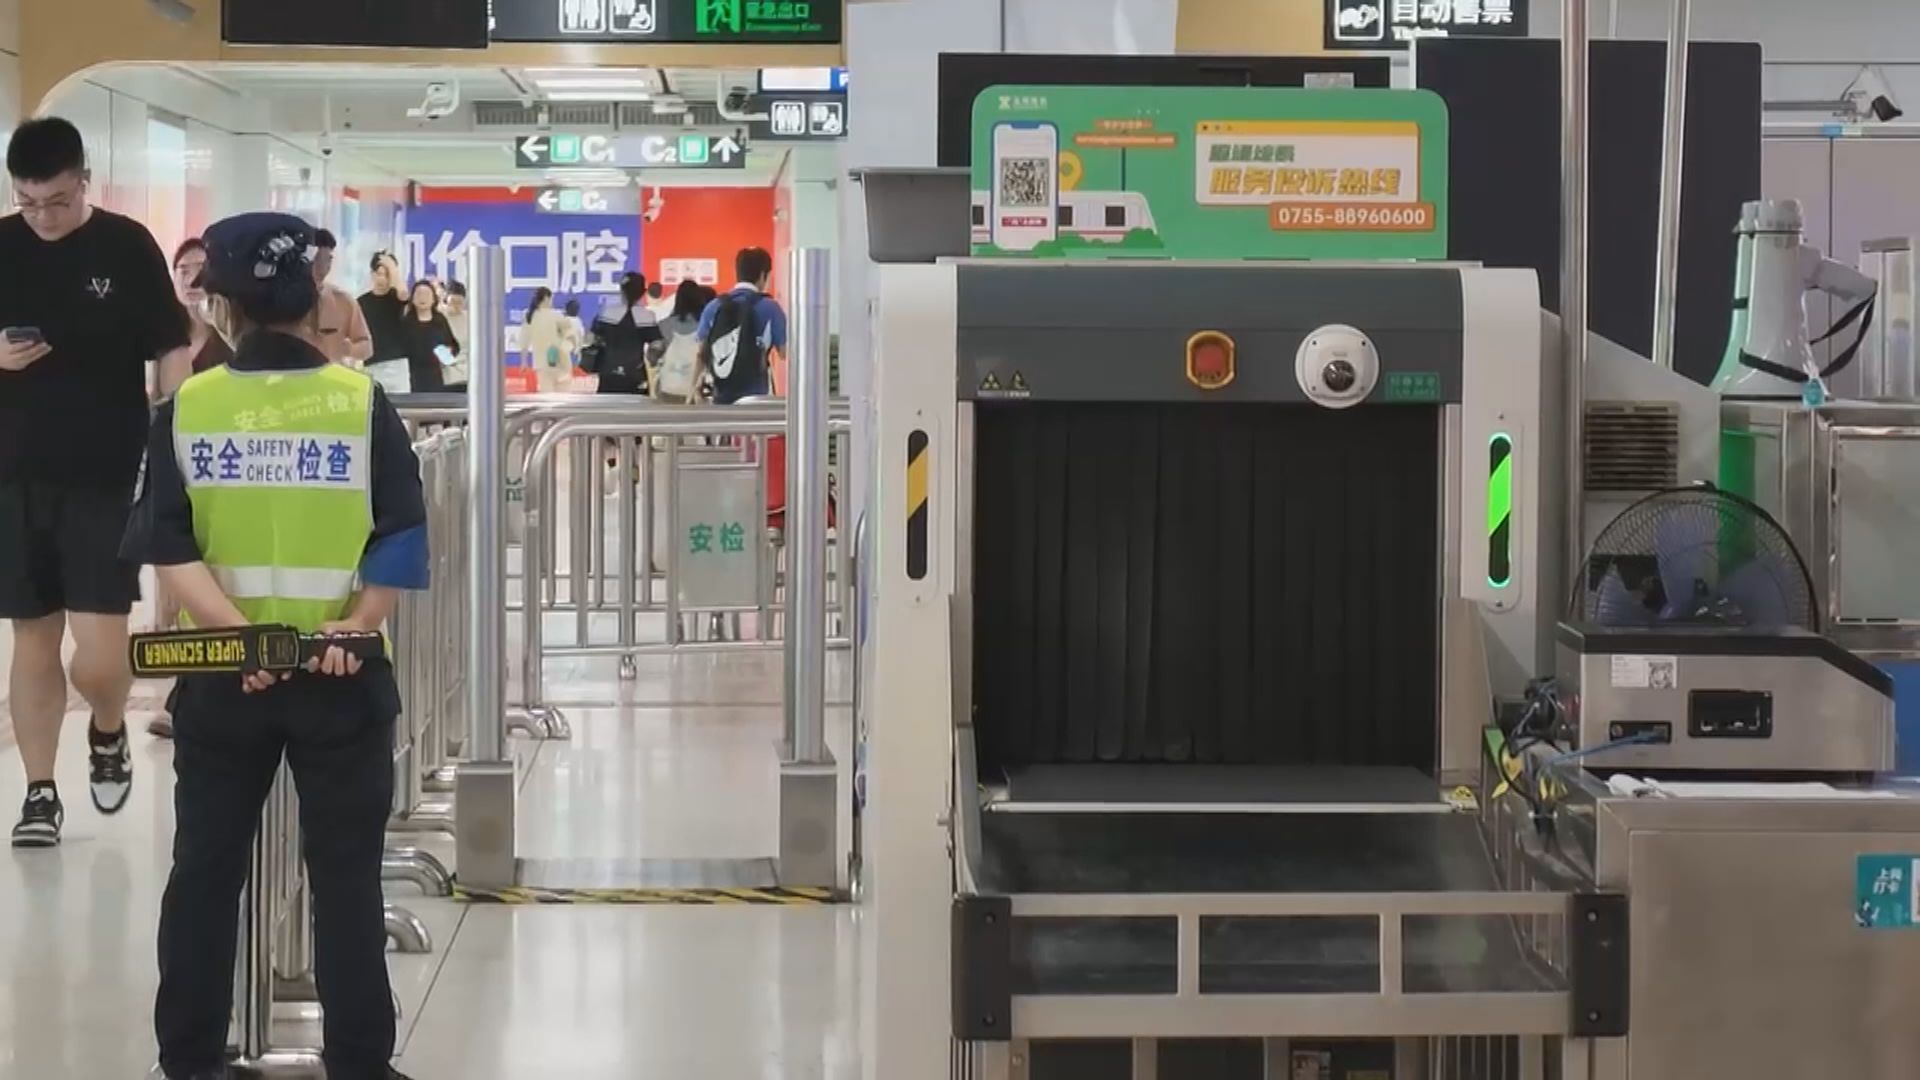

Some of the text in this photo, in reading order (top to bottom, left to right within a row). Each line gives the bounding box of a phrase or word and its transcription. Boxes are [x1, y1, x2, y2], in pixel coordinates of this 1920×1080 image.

[1209, 168, 1401, 195] 服务投诉热线
[1278, 208, 1426, 225] 0755-88960600
[191, 438, 243, 480] 安全
[247, 439, 294, 457] SAFETY
[297, 439, 351, 481] 检查
[246, 464, 293, 481] CHECK
[689, 523, 744, 553] 安检
